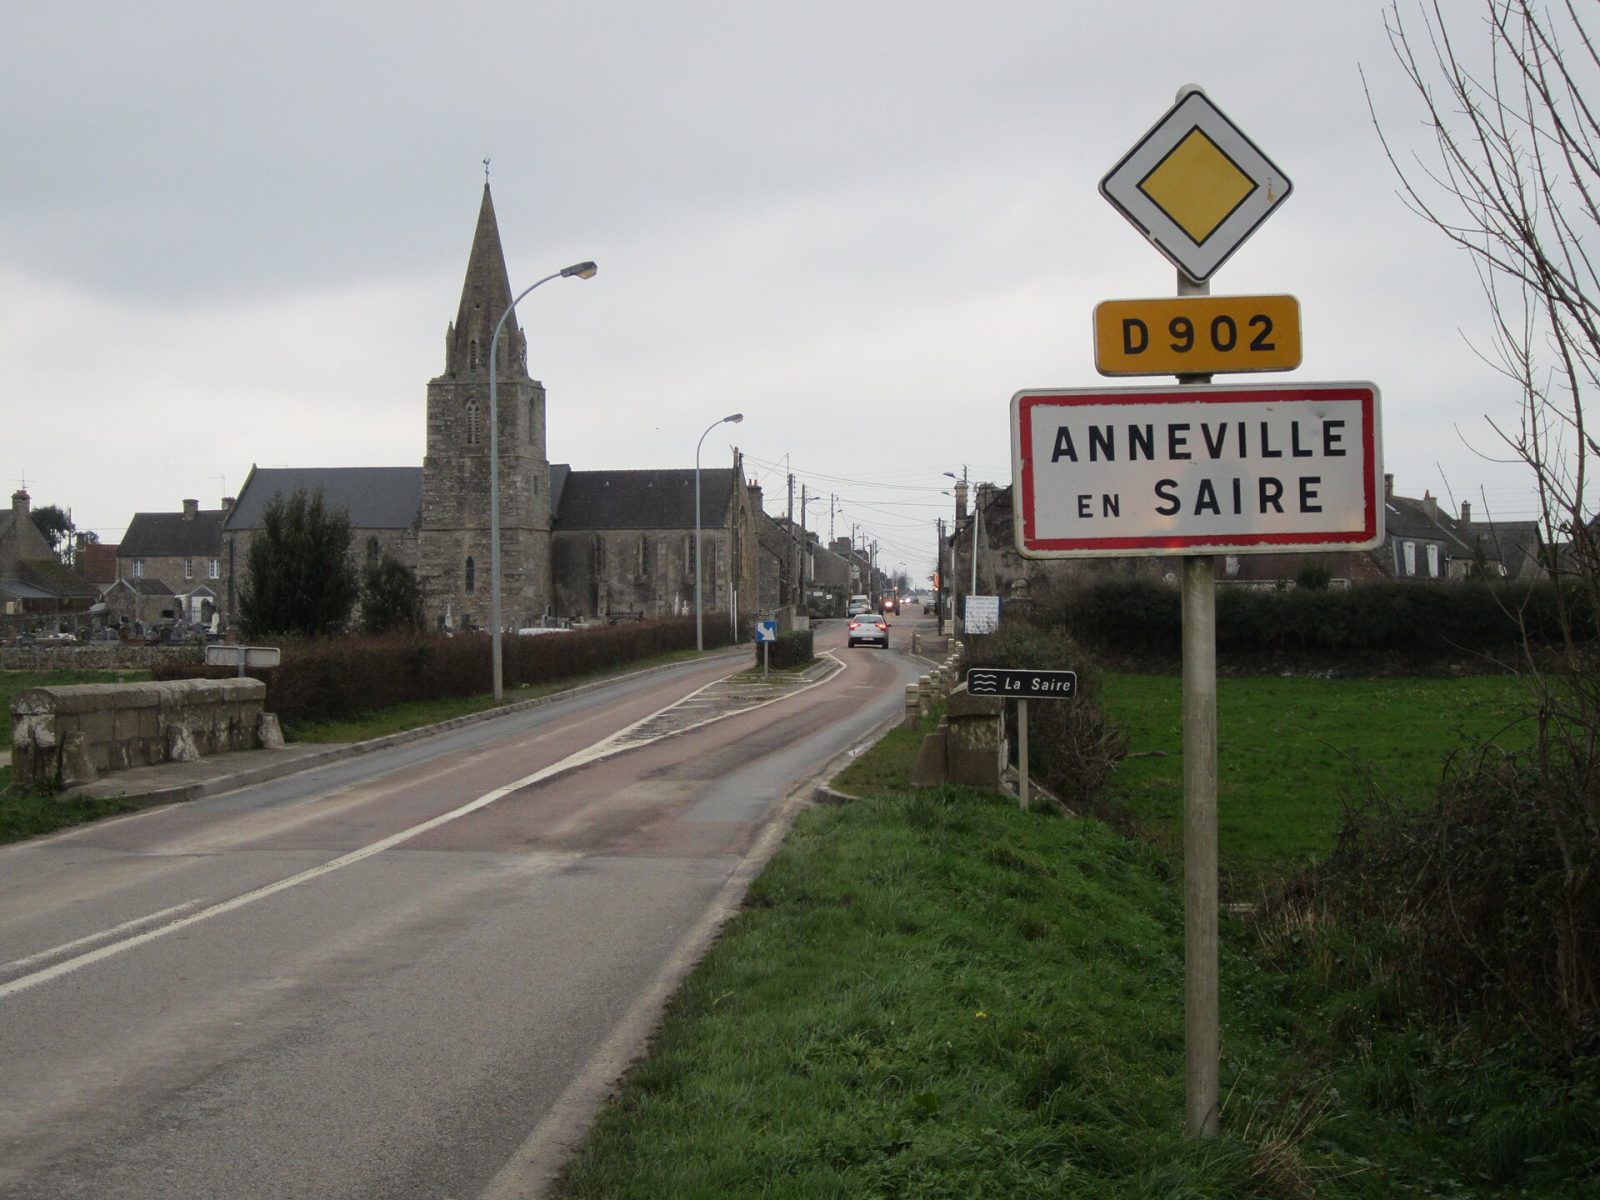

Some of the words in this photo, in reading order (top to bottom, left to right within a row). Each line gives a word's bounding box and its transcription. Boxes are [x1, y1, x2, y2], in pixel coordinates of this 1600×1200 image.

[1122, 318, 1149, 355] D
[1168, 314, 1276, 353] 902
[1050, 420, 1347, 463] ANNEVILLE
[1077, 493, 1121, 519] EN
[1154, 476, 1323, 516] SAIRE
[1004, 677, 1021, 690] La
[1031, 678, 1071, 691] Saire
